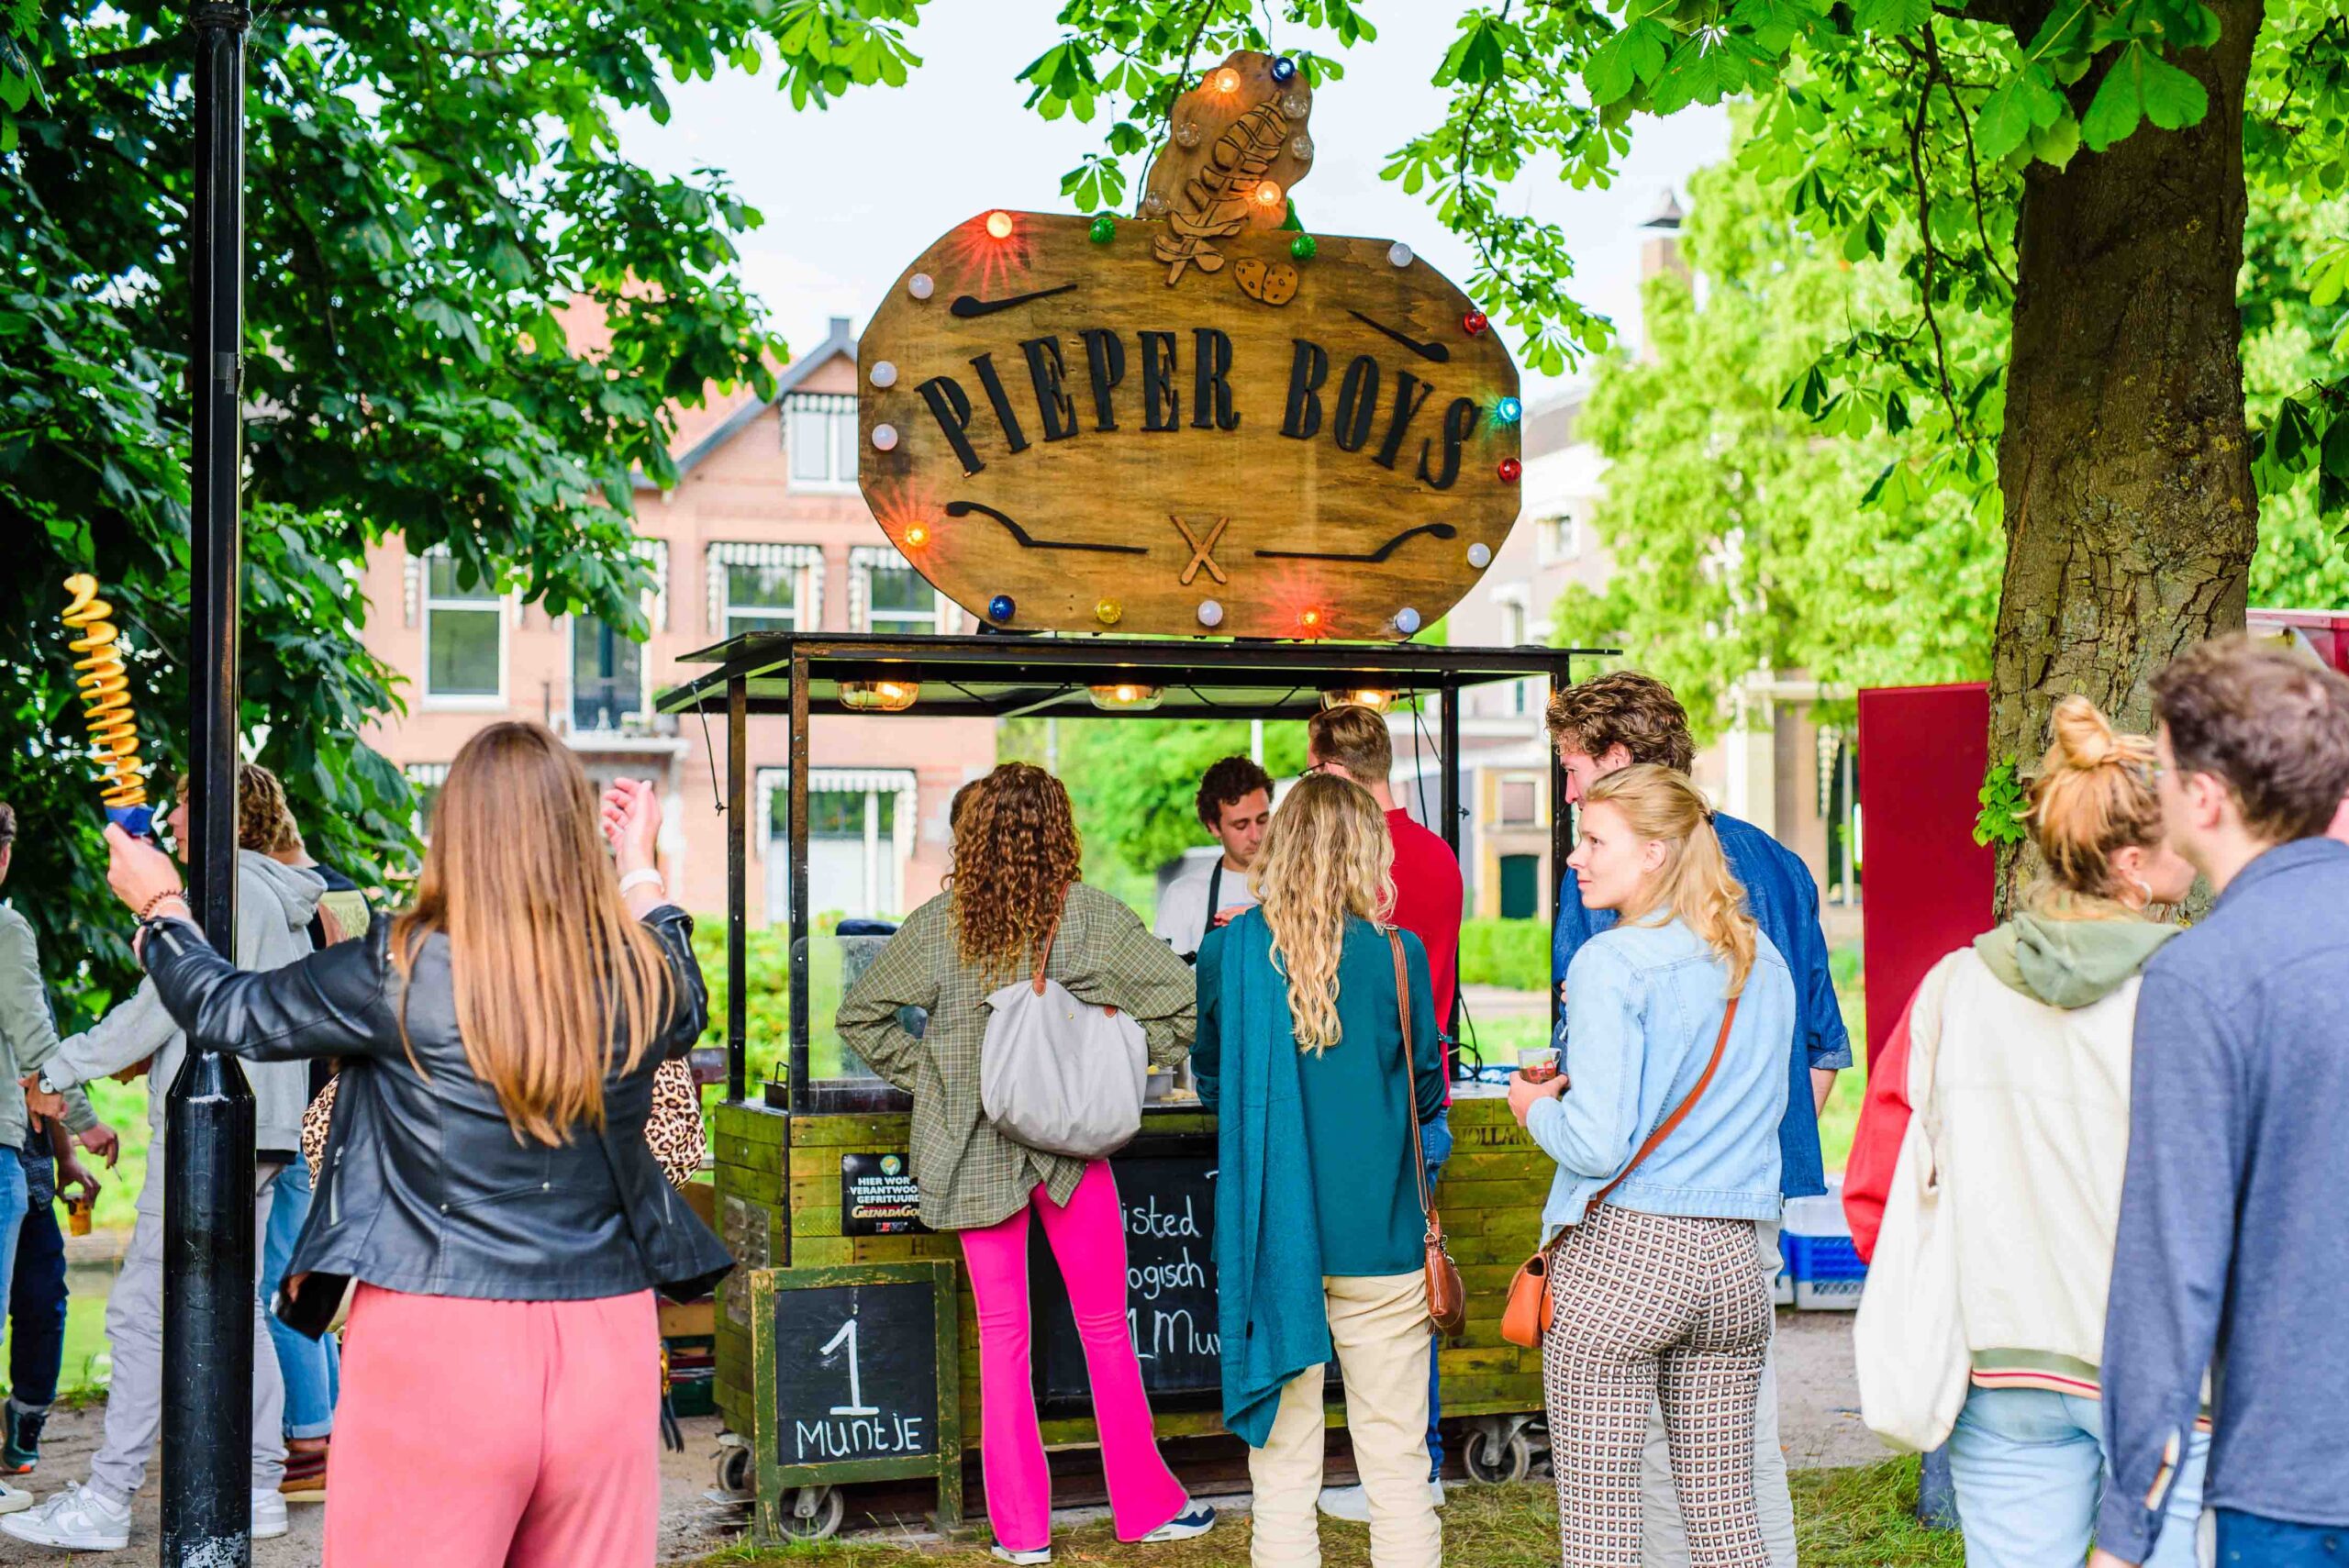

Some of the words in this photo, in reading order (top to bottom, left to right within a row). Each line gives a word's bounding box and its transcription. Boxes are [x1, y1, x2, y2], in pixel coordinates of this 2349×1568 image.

[914, 327, 1241, 478] PIEPER
[1279, 339, 1483, 490] BOYS
[850, 1184, 918, 1195] VERANTWOO
[857, 1176, 883, 1186] HIER
[884, 1176, 910, 1185] WOR
[1122, 1195, 1203, 1239] isted
[1128, 1246, 1205, 1300] ogisch
[819, 1318, 880, 1416] 1
